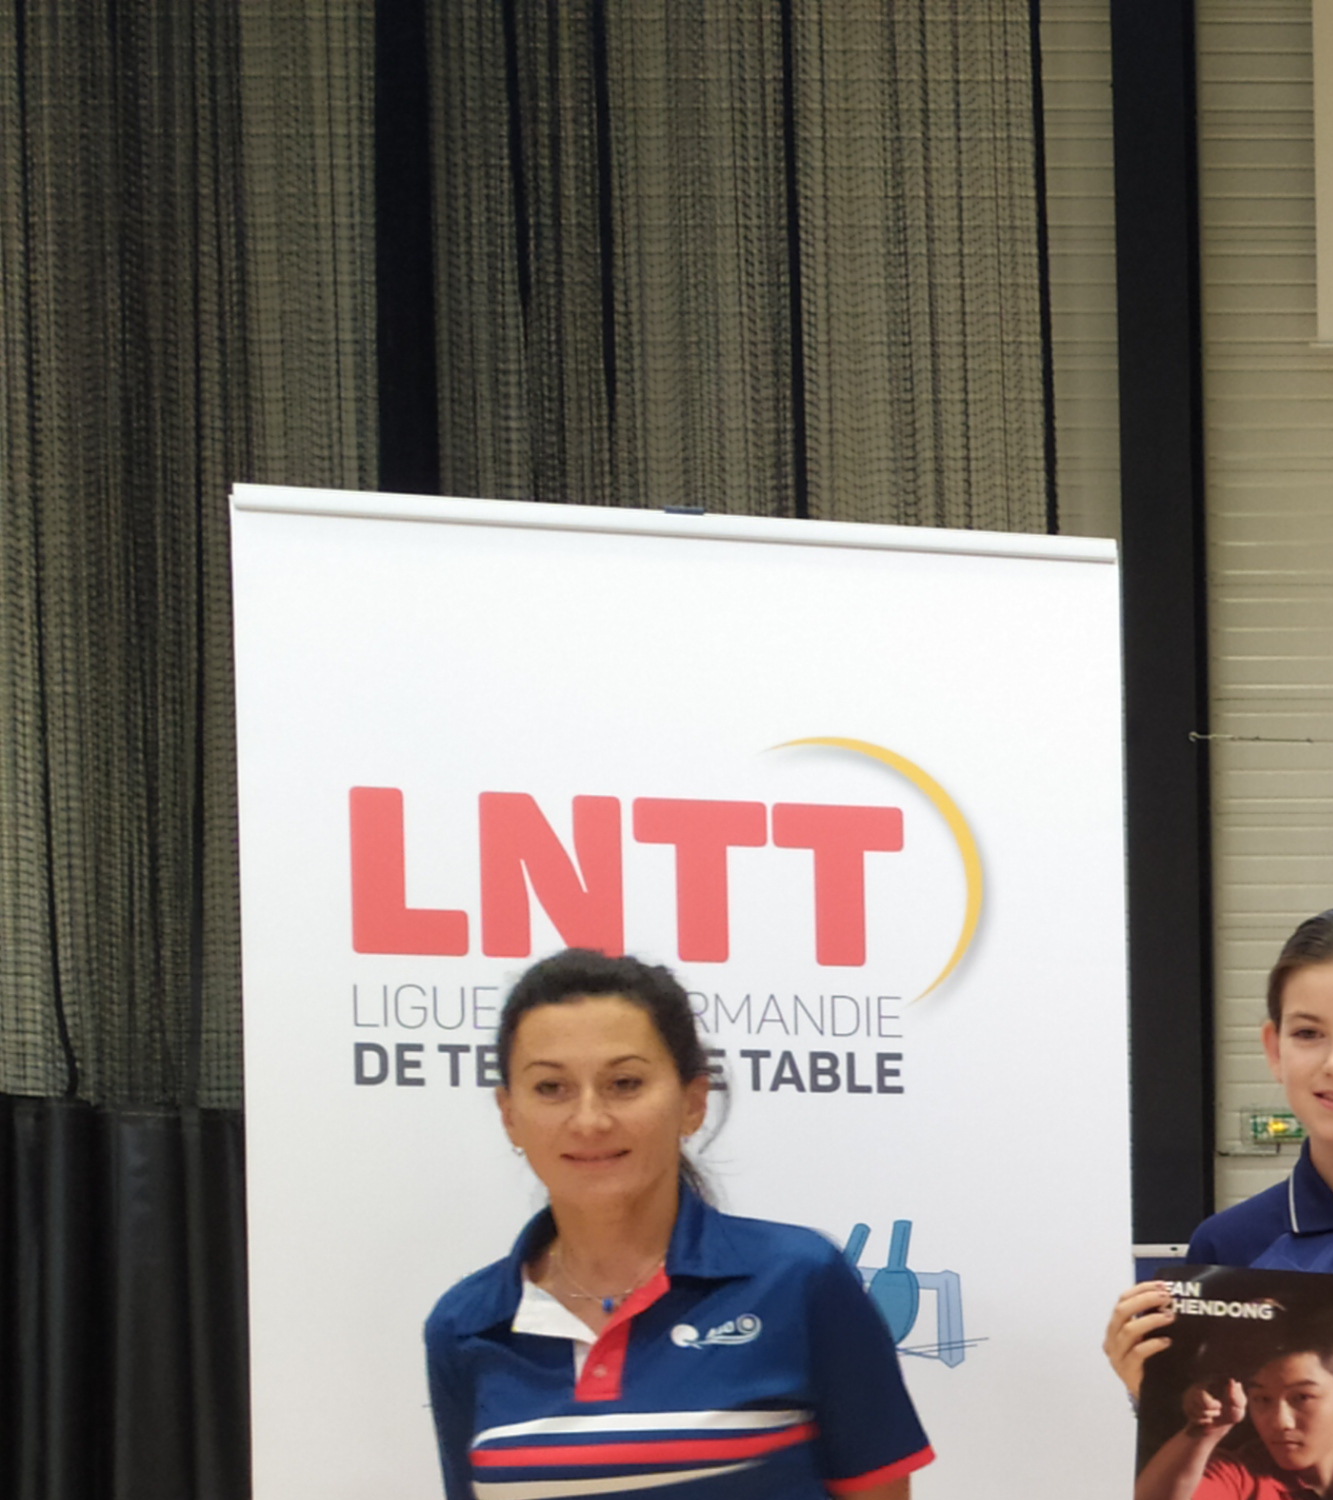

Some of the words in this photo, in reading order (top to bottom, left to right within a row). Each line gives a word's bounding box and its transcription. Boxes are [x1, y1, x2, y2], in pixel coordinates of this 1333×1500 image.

[348, 786, 904, 967] LNTT
[352, 983, 500, 1031] LIGUE
[687, 992, 904, 1038] RMANDIE
[353, 1043, 426, 1088] DE
[739, 1048, 905, 1094] TABLE
[1172, 1298, 1274, 1320] HENDONG
